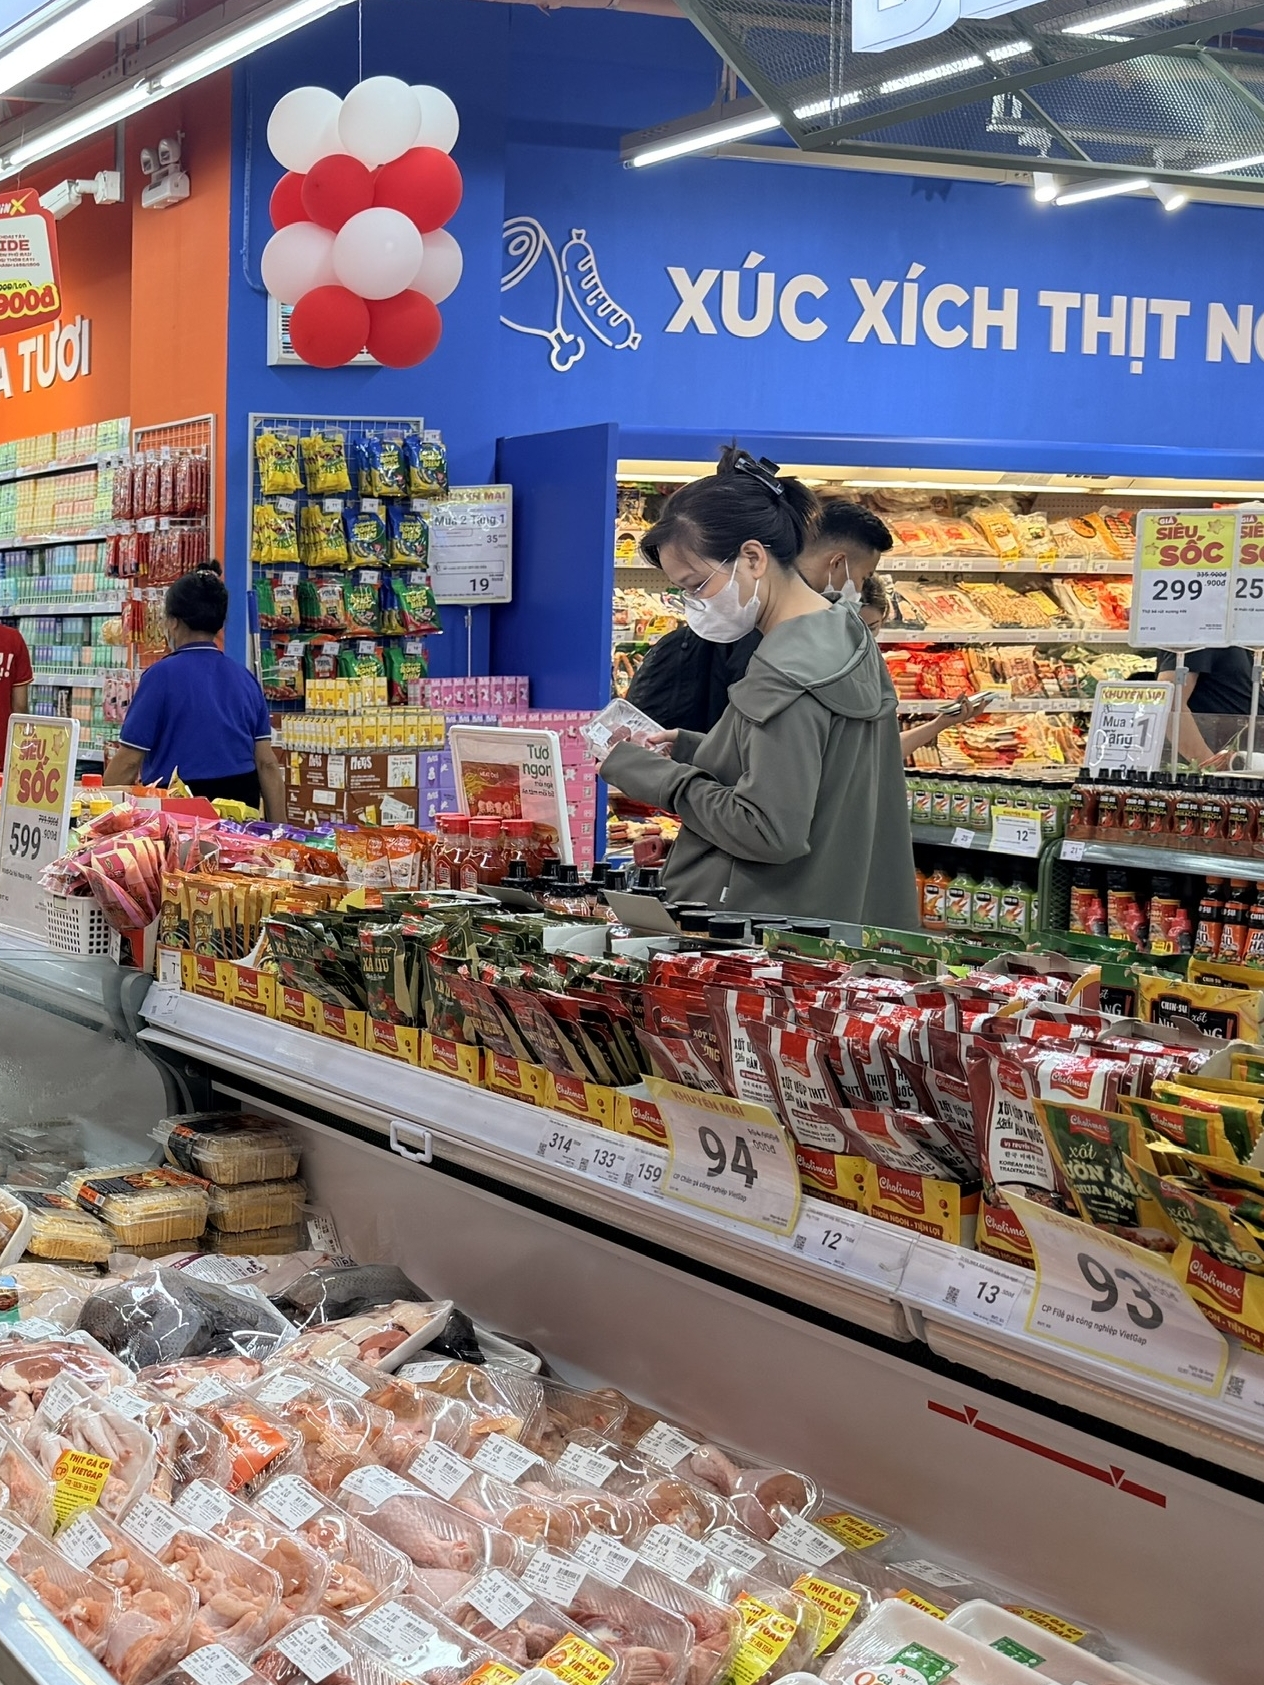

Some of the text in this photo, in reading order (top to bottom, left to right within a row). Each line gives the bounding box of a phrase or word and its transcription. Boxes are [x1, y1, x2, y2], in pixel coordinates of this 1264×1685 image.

[664, 250, 1264, 375] XÚC XÍCH THỊT N
[18, 314, 92, 393] TƯƠI
[460, 515, 467, 525] 2
[500, 514, 505, 523] 1
[1159, 516, 1174, 525] GIÁ
[486, 534, 498, 544] 35
[1156, 523, 1199, 541] SIÊU
[1158, 534, 1225, 567] SỐC
[469, 578, 490, 592] 19
[1152, 579, 1203, 601] 299
[1102, 715, 1126, 728] Mua
[17, 757, 61, 804] SỐC
[9, 822, 41, 861] 599
[1016, 830, 1028, 842] 12
[1160, 1000, 1208, 1024] CHIN-SU xốt
[432, 1043, 457, 1062] Cholimex
[493, 1059, 519, 1079] Cholimex
[781, 1076, 793, 1090] XỐT
[808, 1087, 828, 1101] THỊT
[866, 1073, 886, 1087] THỊT
[998, 1073, 1025, 1090] Cholimex
[1052, 1071, 1090, 1090] Cholimex
[555, 1081, 586, 1101] Cholimex
[671, 1088, 746, 1118] KHUYẾN MẠI
[796, 1098, 808, 1111] HÀN
[998, 1101, 1012, 1117] XỐT
[631, 1106, 665, 1127] Cholimex
[1070, 1114, 1109, 1132] Cholimex
[1150, 1113, 1184, 1132] Cholimex
[548, 1132, 573, 1154] 314
[1069, 1142, 1097, 1160] xốt
[593, 1148, 616, 1169] 133
[698, 1125, 758, 1189] 94
[796, 1154, 835, 1177] Cholimex
[999, 1160, 1019, 1169] KOREAN
[637, 1162, 662, 1183] 159
[999, 1166, 1036, 1176] TRADITIONAL
[692, 1177, 699, 1188] gà
[699, 1180, 711, 1192] công
[711, 1183, 727, 1196] nghiệp
[878, 1174, 923, 1200] Cholimex
[1103, 1185, 1135, 1209] NGỌT
[1167, 1205, 1195, 1221] xốt
[889, 1213, 910, 1226] NGON
[914, 1221, 929, 1233] TIỆN
[929, 1225, 941, 1236] LỢI
[986, 1213, 1026, 1238] Cholime
[820, 1228, 843, 1251] 12
[1189, 1258, 1242, 1300] Cholimex
[976, 1280, 1000, 1304] 13
[1077, 1252, 1164, 1330] 93
[1041, 1304, 1051, 1313] CP
[1065, 1312, 1074, 1323] gà
[1075, 1316, 1093, 1330] công
[1093, 1320, 1118, 1336] nghiệp
[1119, 1329, 1148, 1346] VietGap
[232, 1418, 276, 1456] Gà tươi
[69, 1452, 110, 1471] THỊT GÀ CP
[55, 1465, 103, 1480] CP VIETGAP
[808, 1582, 857, 1606] THỊT GÀ CP
[1067, 1627, 1083, 1636] CP
[597, 1661, 610, 1673] CP
